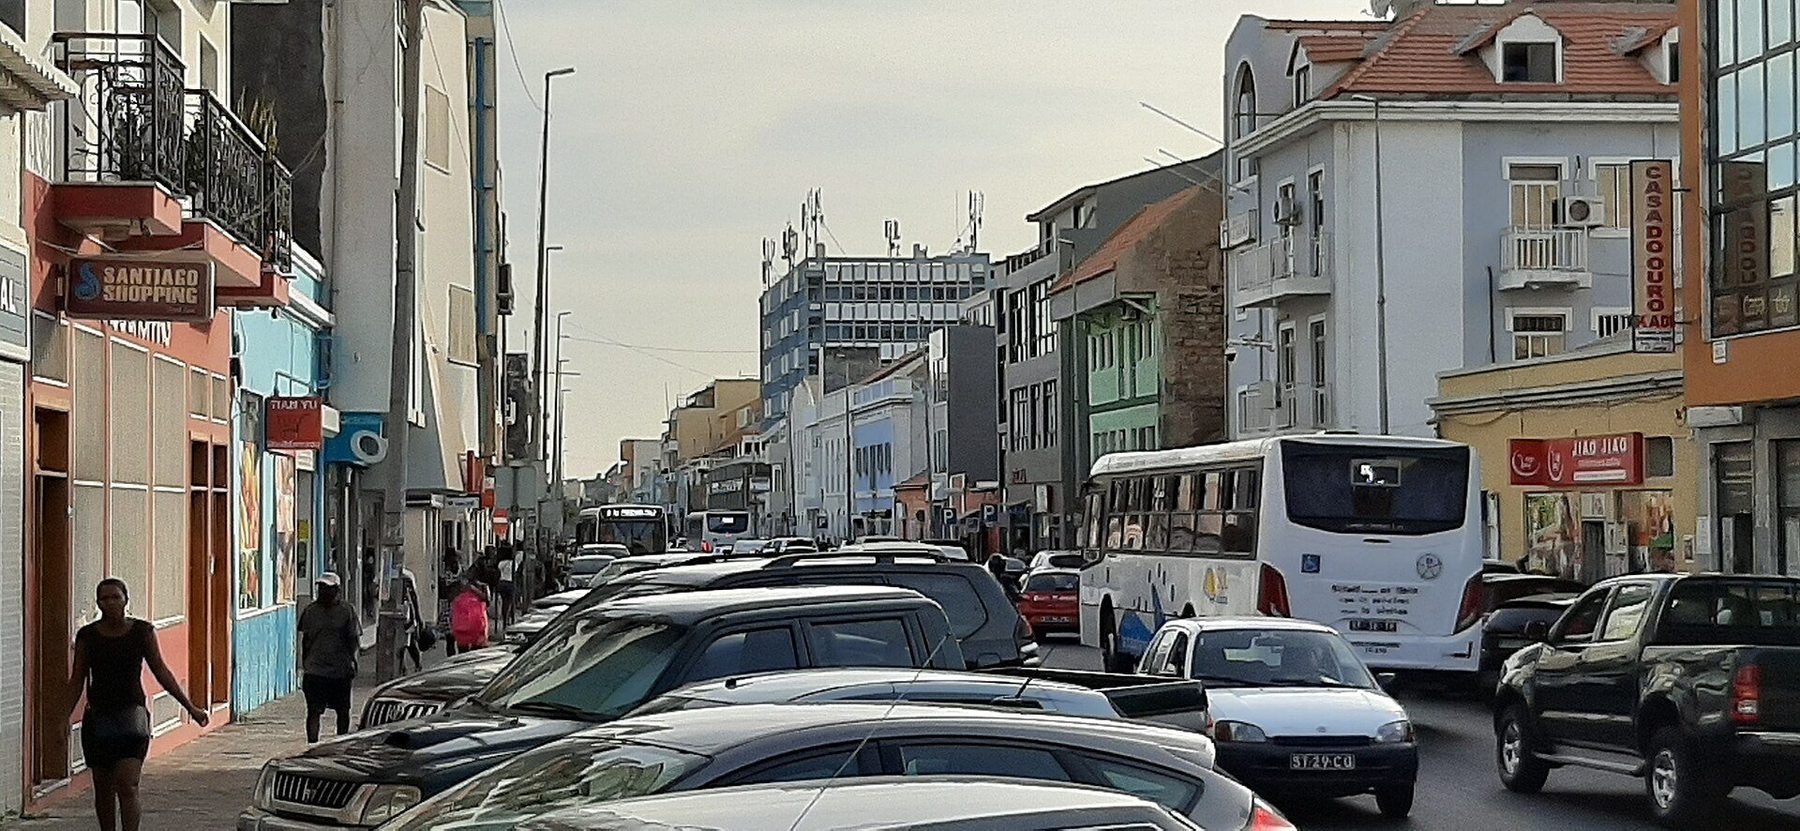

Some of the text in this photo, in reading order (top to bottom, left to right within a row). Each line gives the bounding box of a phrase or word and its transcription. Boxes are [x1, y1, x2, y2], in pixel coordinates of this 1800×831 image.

[103, 266, 200, 287] SANTIAGO
[103, 285, 199, 304] SHOPPING
[1572, 436, 1628, 457] JIAO JIAO
[943, 508, 954, 525] P
[983, 504, 995, 520] P
